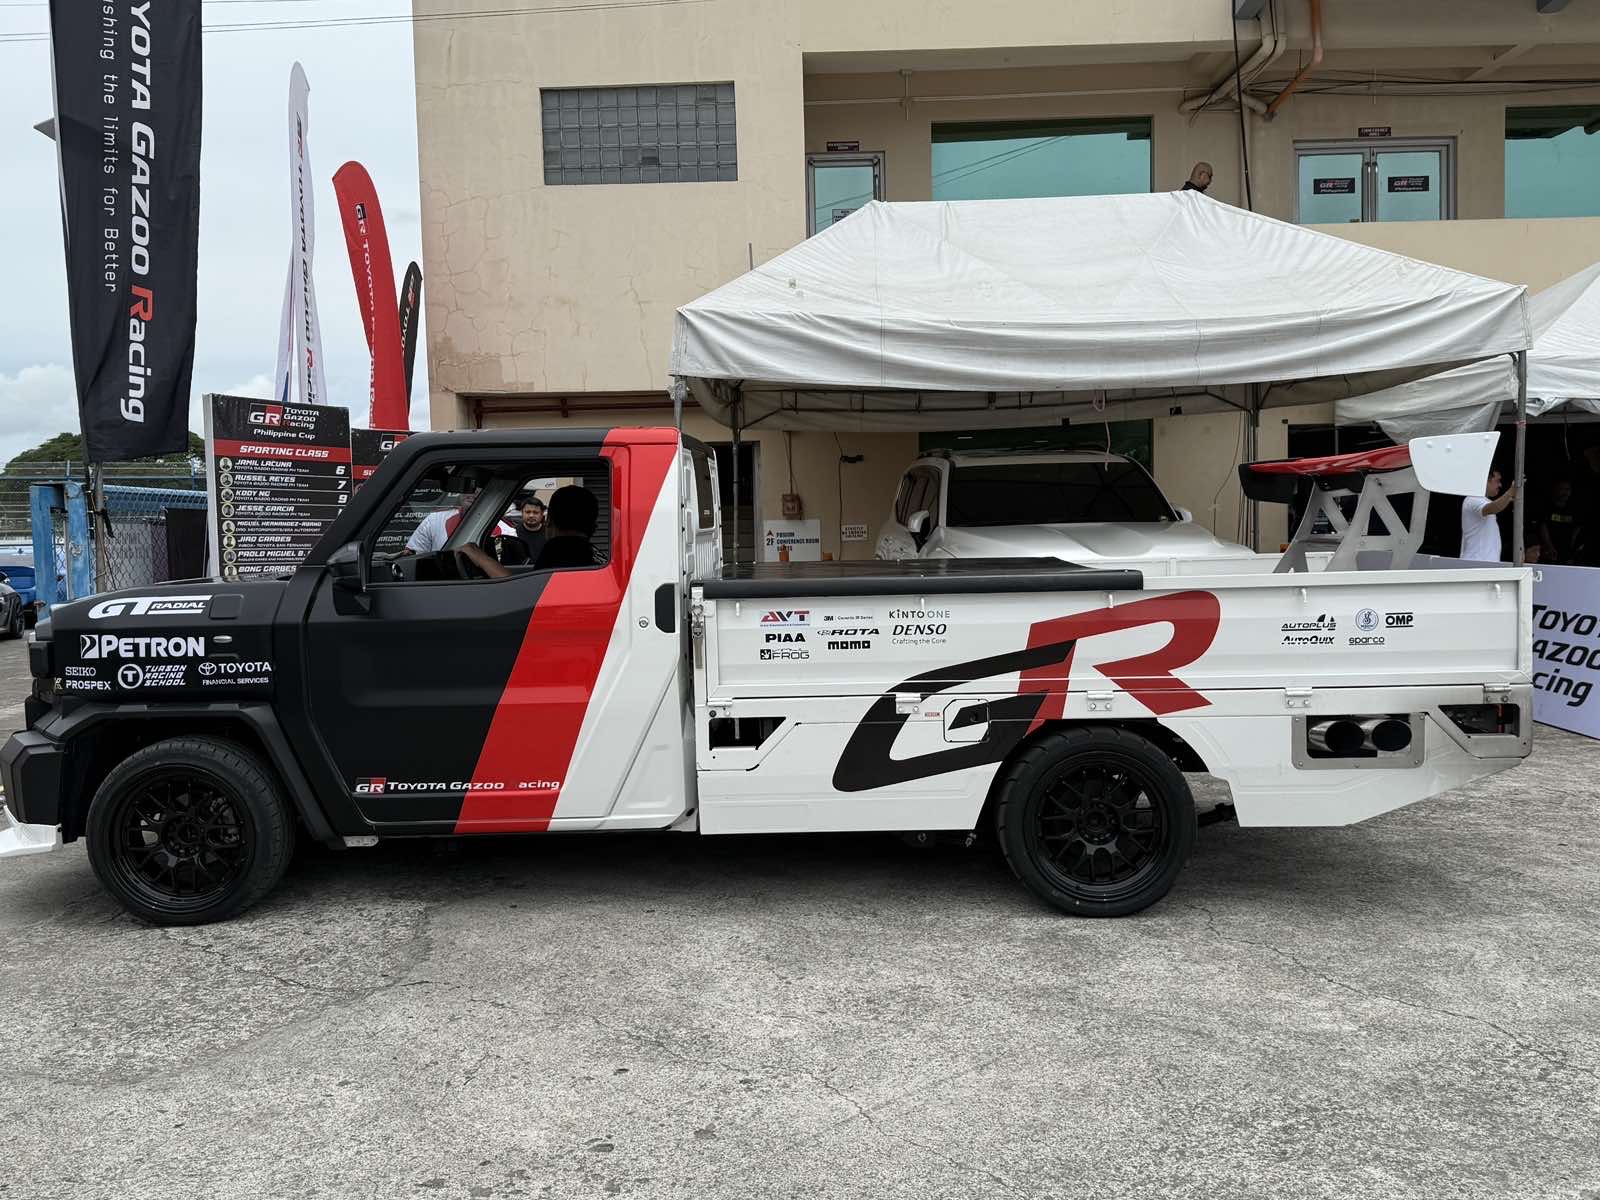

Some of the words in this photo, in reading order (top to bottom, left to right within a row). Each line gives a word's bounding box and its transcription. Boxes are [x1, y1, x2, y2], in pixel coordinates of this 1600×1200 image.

[100, 0, 118, 59] shing
[104, 74, 118, 104] the
[104, 117, 118, 174] limits
[104, 187, 118, 216] for
[131, 121, 155, 275] GAZOO
[104, 228, 119, 293] Better
[120, 284, 154, 423] Racing
[285, 406, 320, 416] TOYOTA
[248, 411, 281, 425] GR
[283, 413, 317, 422] GAZOO
[253, 428, 297, 439] Philippine
[298, 431, 316, 441] Cup
[239, 445, 294, 456] SPORTING
[295, 449, 329, 458] CLASS
[335, 465, 346, 475] 6
[235, 474, 268, 482] RUSSEL
[337, 481, 347, 490] 7
[338, 494, 348, 504] 9
[766, 538, 775, 546] 2F
[262, 565, 297, 573] GARBES
[150, 601, 207, 610] RADIAL
[760, 610, 811, 623] AVT
[926, 610, 951, 619] ONE
[1385, 614, 1414, 626] OMP
[1533, 604, 1600, 638] TOYO
[830, 628, 880, 636] ROTA
[892, 623, 947, 636] DENSO
[765, 633, 806, 643] PIAA
[1348, 636, 1385, 645] sparco
[101, 634, 206, 658] PETRON
[827, 640, 872, 650] momo
[772, 651, 810, 660] FROG
[65, 666, 97, 677] SEIKO
[218, 661, 273, 674] TOYOTA
[144, 671, 185, 680] RACING
[237, 677, 269, 685] SERVICES
[65, 680, 112, 690] PROSPEX
[144, 678, 187, 687] SCHOOL
[832, 590, 1221, 792] GR
[355, 783, 385, 793] GR
[386, 781, 447, 791] TOYOTA
[449, 781, 505, 791] GAZOO
[518, 779, 560, 791] acing
